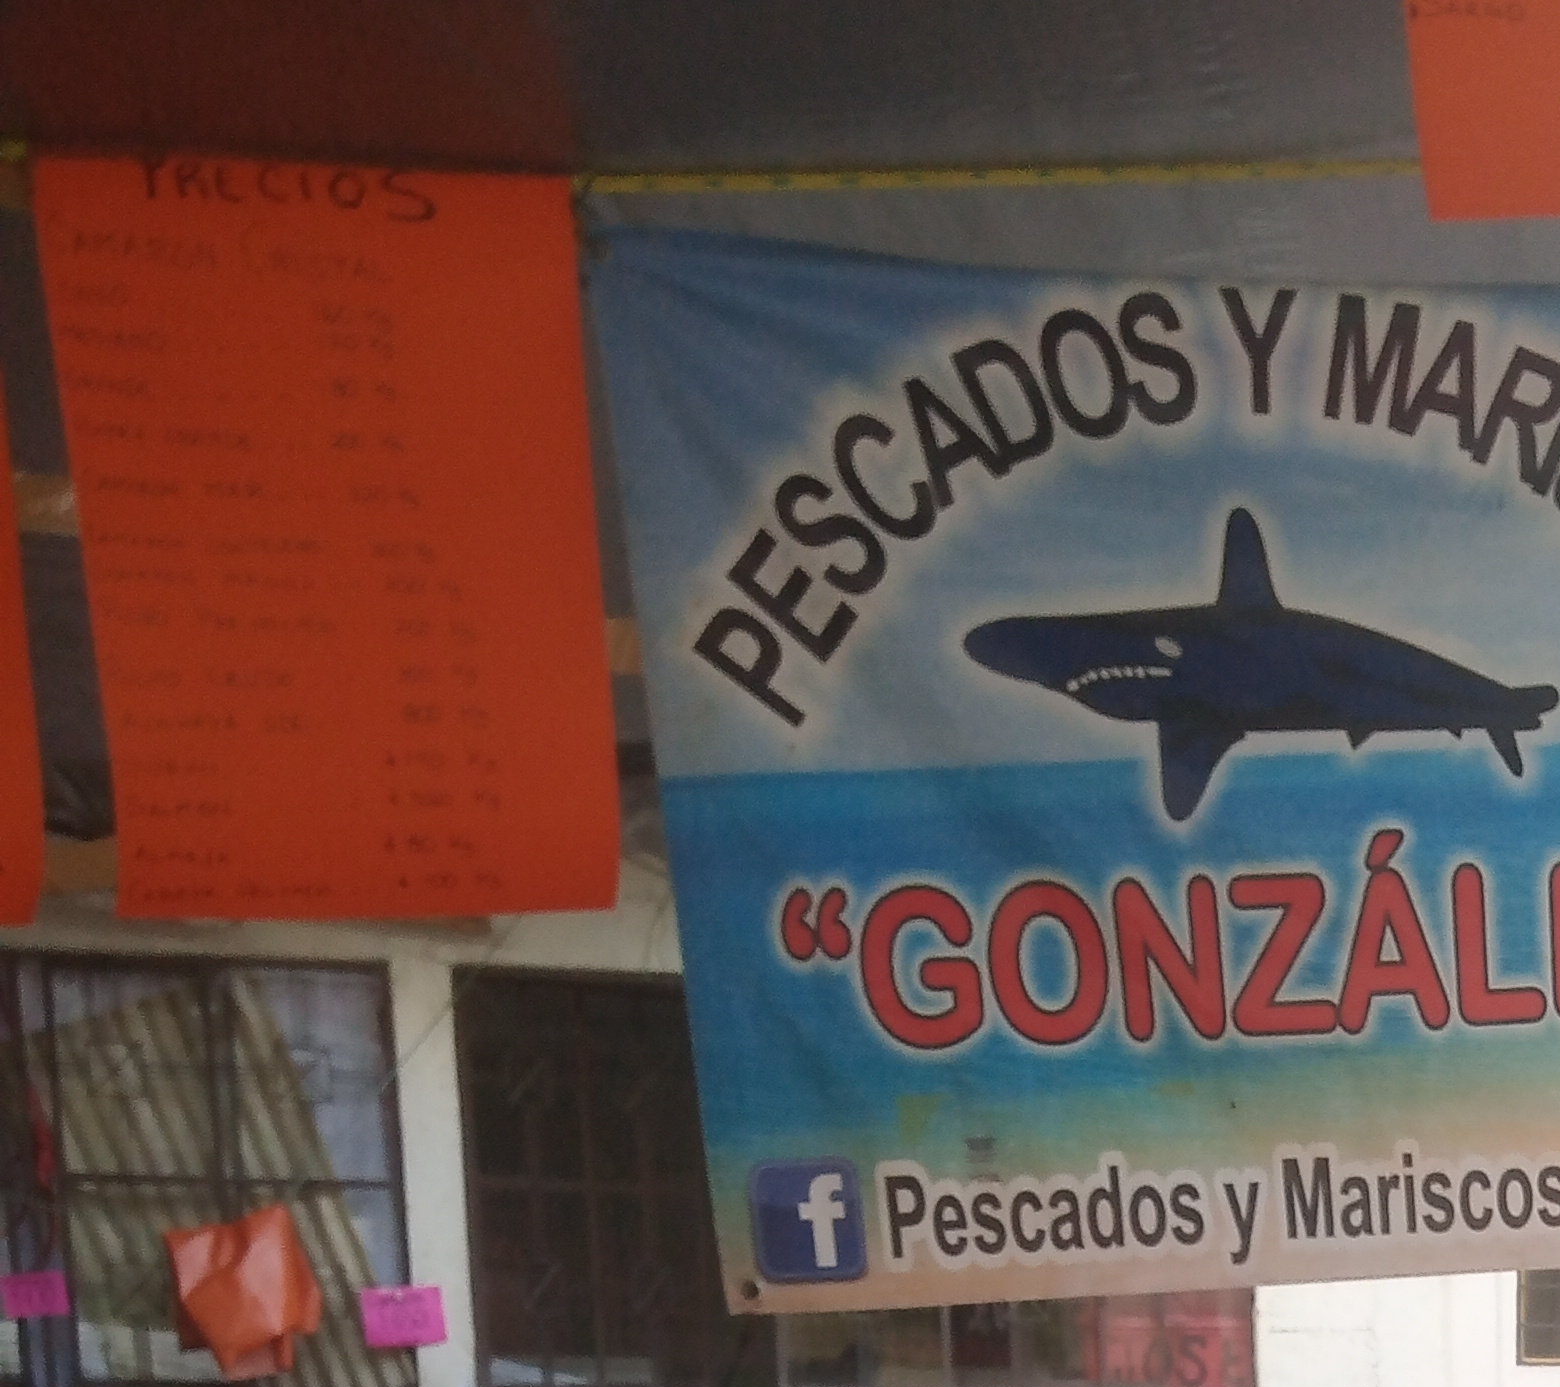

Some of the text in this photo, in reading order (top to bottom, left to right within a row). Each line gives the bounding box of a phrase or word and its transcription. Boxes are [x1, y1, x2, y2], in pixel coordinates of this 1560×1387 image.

[692, 292, 1198, 728] PESCADOS
[1218, 286, 1298, 415] Y
[883, 1165, 1206, 1261] Pescados
[1223, 1180, 1260, 1267] y
